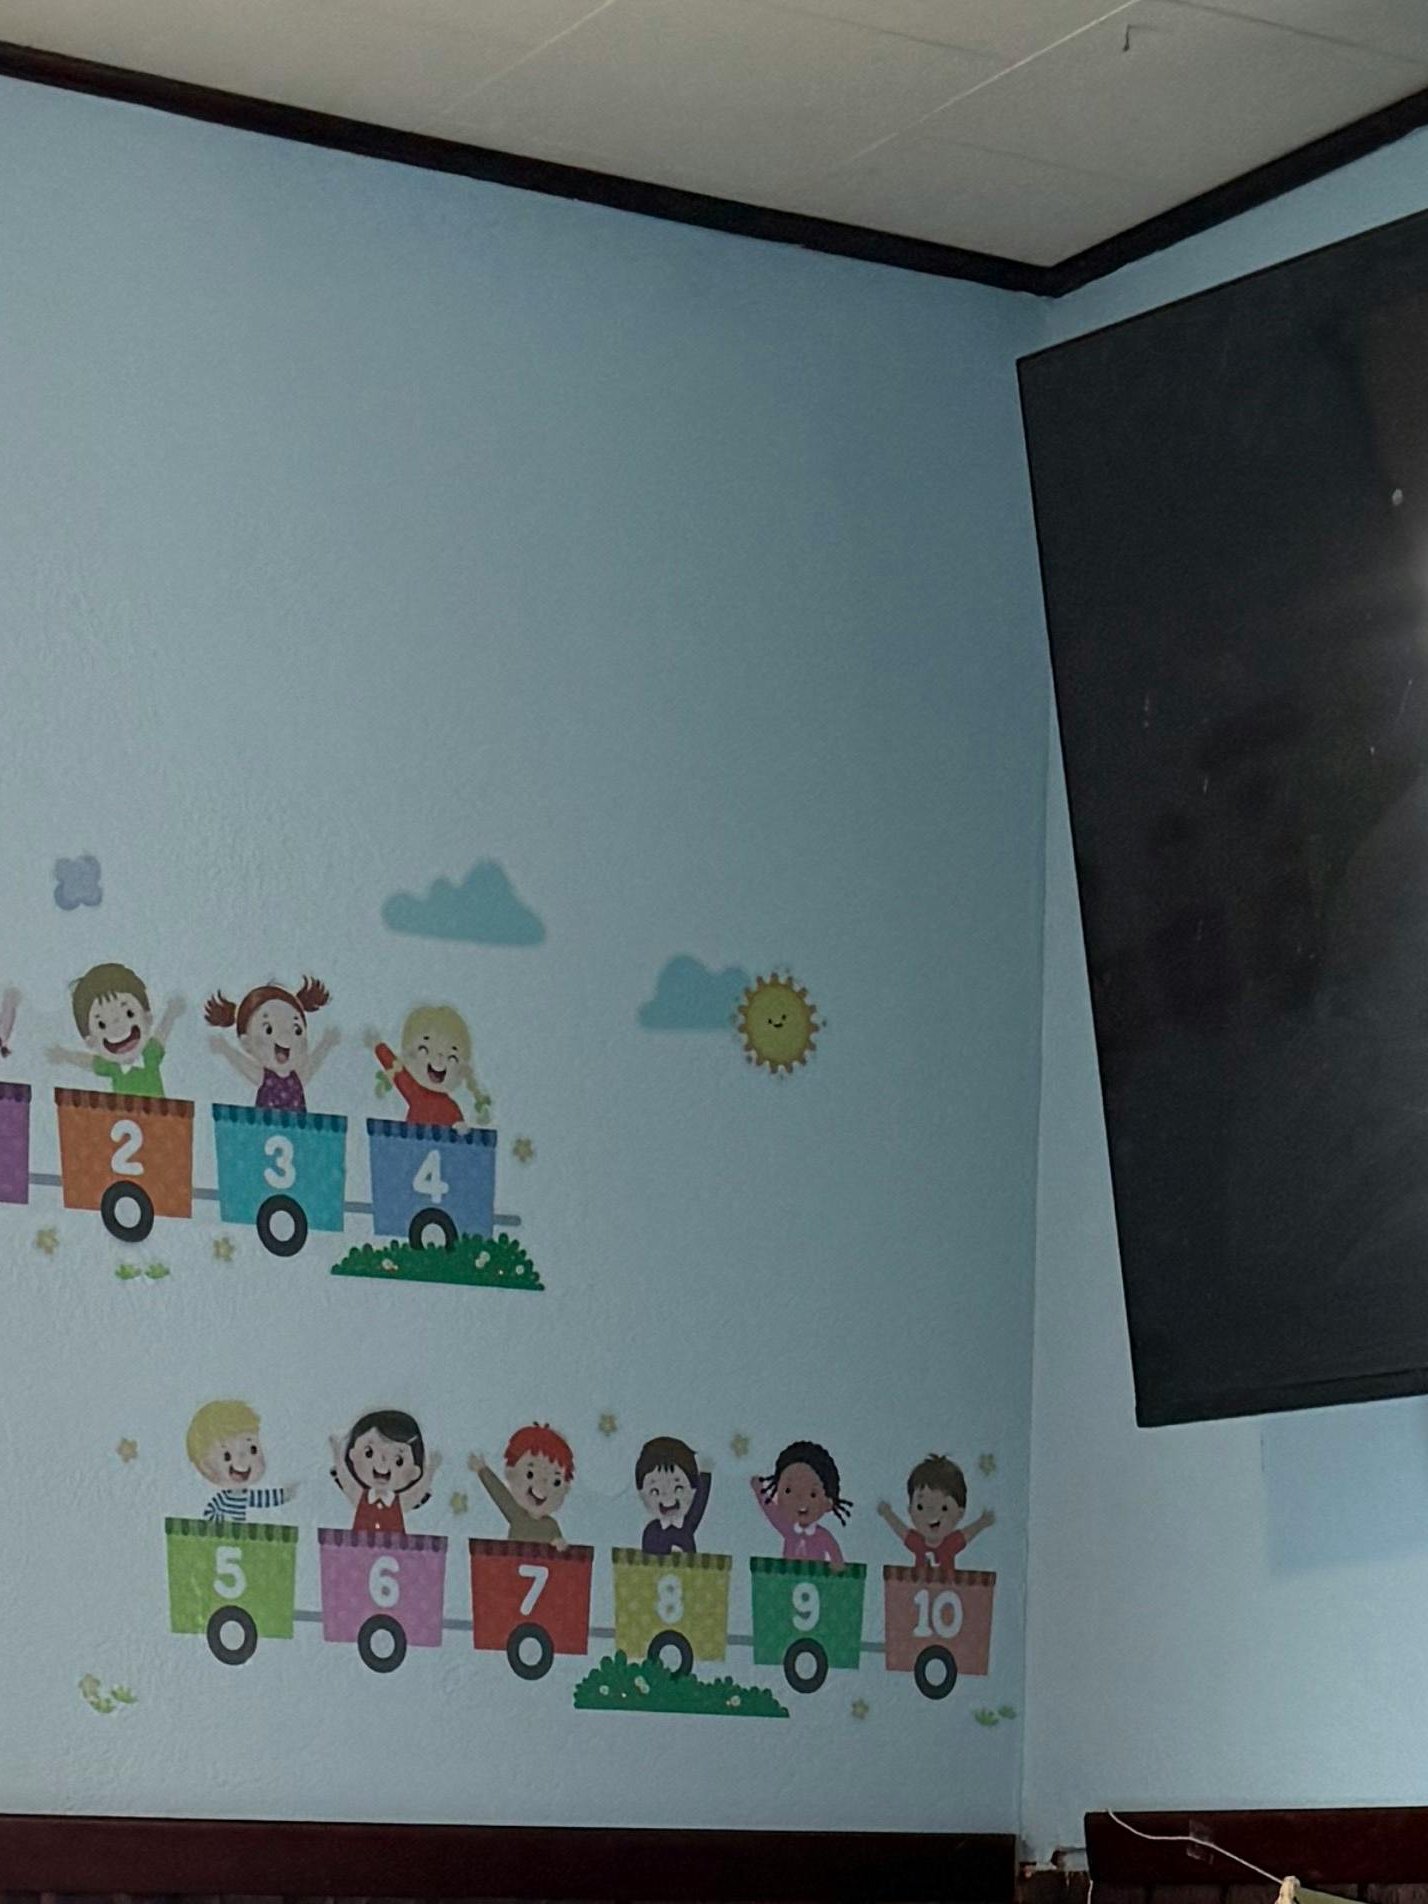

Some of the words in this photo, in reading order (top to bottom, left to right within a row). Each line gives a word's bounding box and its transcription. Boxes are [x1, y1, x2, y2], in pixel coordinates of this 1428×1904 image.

[109, 1119, 145, 1176] 2
[263, 1135, 297, 1189] 3
[412, 1149, 450, 1204] 4
[214, 1546, 246, 1599] 5
[369, 1557, 401, 1607] 6
[517, 1565, 550, 1616] 7
[656, 1575, 684, 1621] 8
[791, 1583, 820, 1632] 9
[913, 1589, 963, 1638] 10
